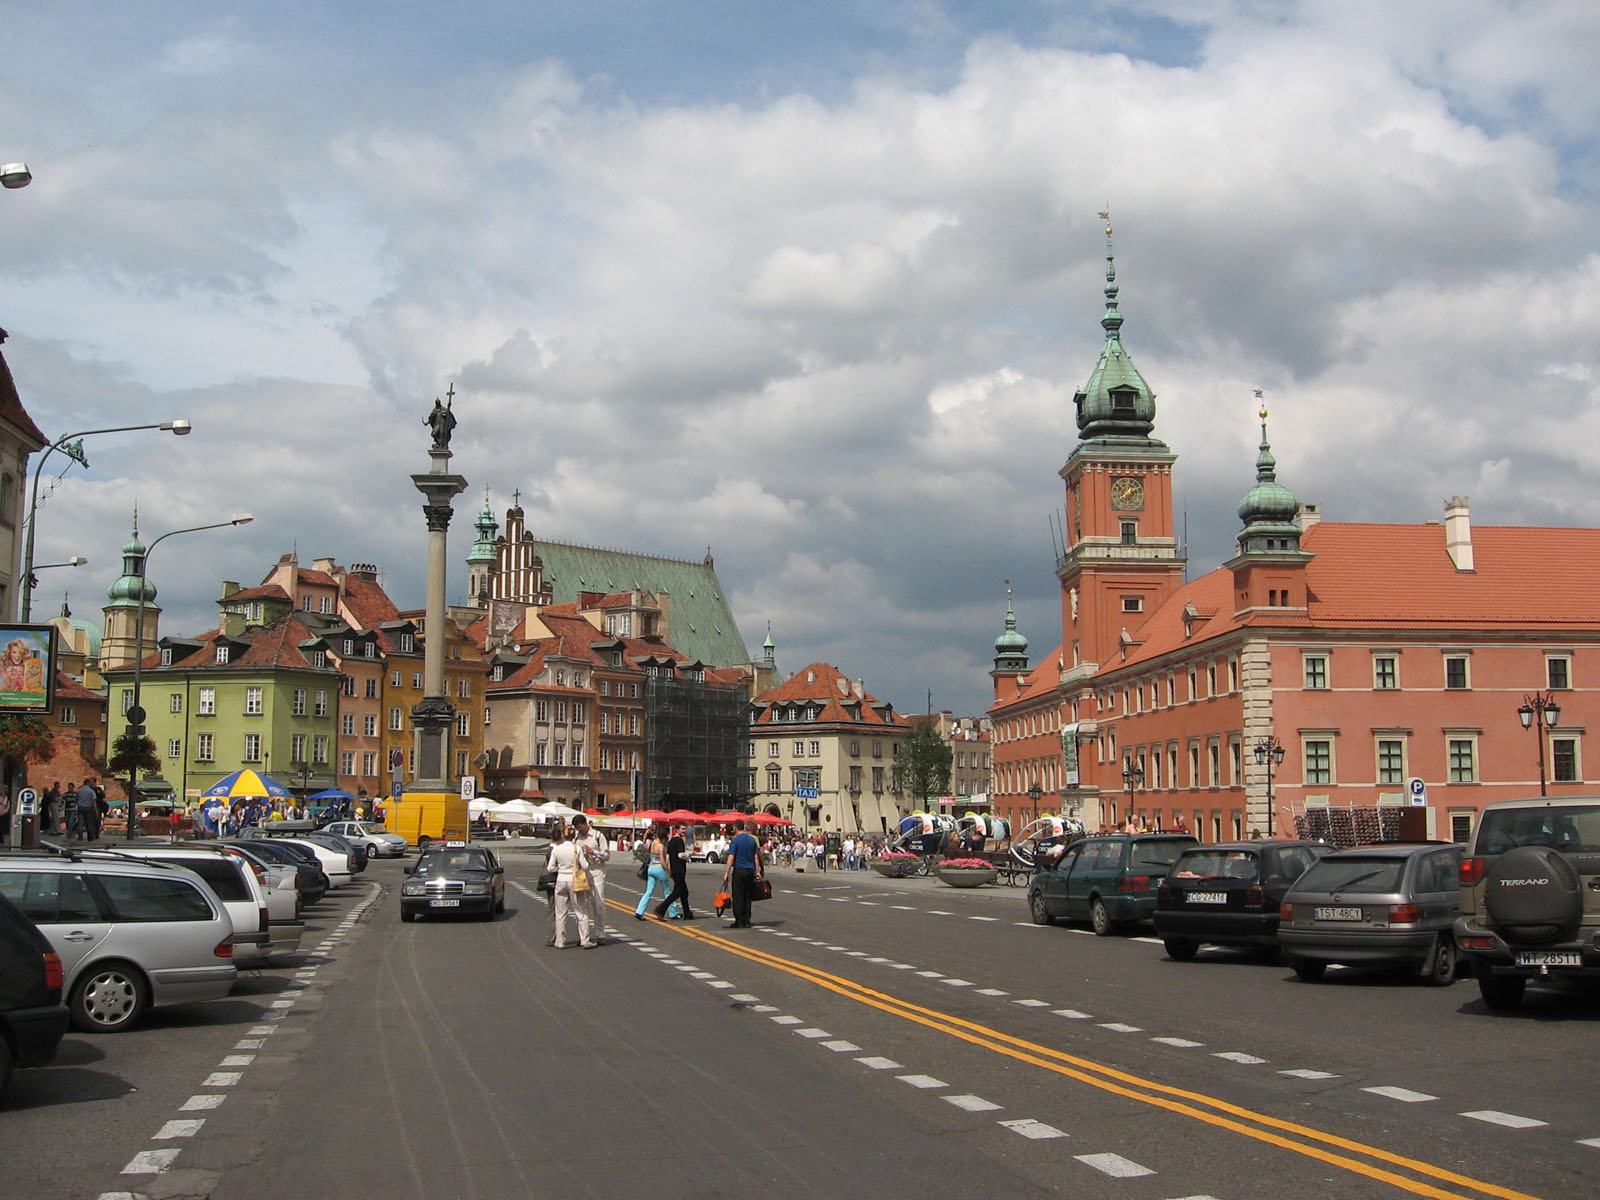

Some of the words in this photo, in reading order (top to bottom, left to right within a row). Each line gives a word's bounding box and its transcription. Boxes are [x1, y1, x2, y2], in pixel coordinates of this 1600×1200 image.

[395, 783, 402, 795] P
[465, 784, 472, 792] 20
[1413, 782, 1423, 793] P
[23, 792, 33, 802] P
[798, 788, 817, 798] TAXI
[1320, 908, 1336, 918] TST
[1522, 952, 1539, 964] WT
[1543, 952, 1577, 964] 28511
